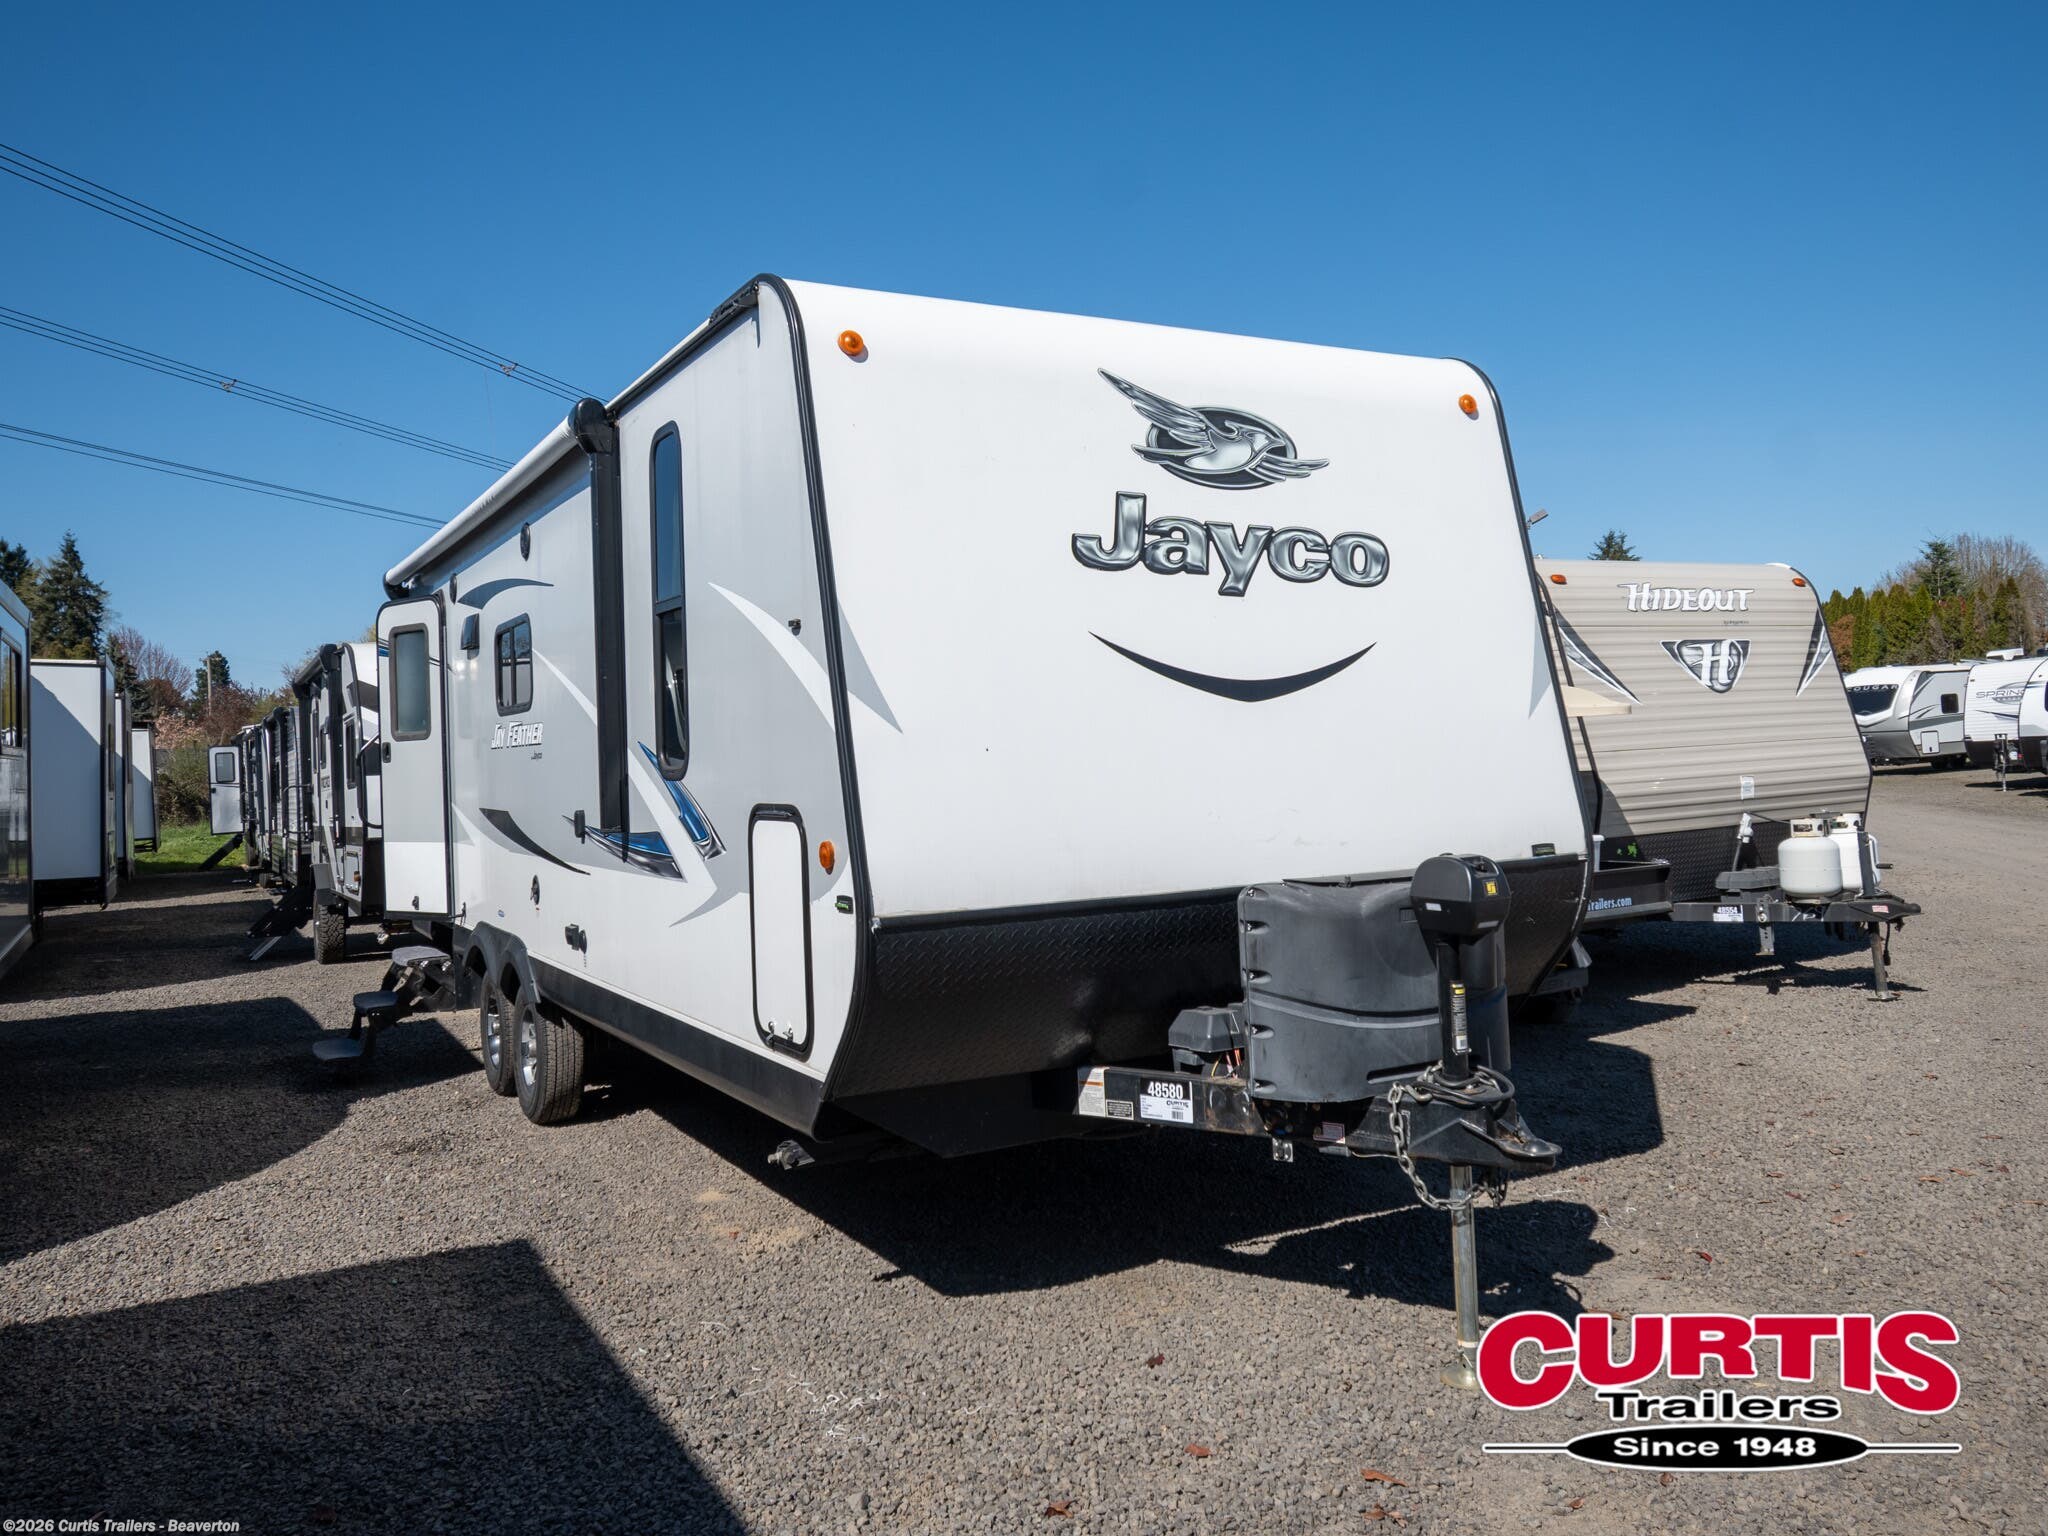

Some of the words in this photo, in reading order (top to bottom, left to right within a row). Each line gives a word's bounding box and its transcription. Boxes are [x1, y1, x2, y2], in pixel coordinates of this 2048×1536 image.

[1072, 491, 1390, 597] Jayco
[1617, 582, 1754, 612] HIDEOUT
[491, 723, 506, 749] JAY
[506, 721, 543, 748] FEATHER
[1147, 1081, 1183, 1099] 48580
